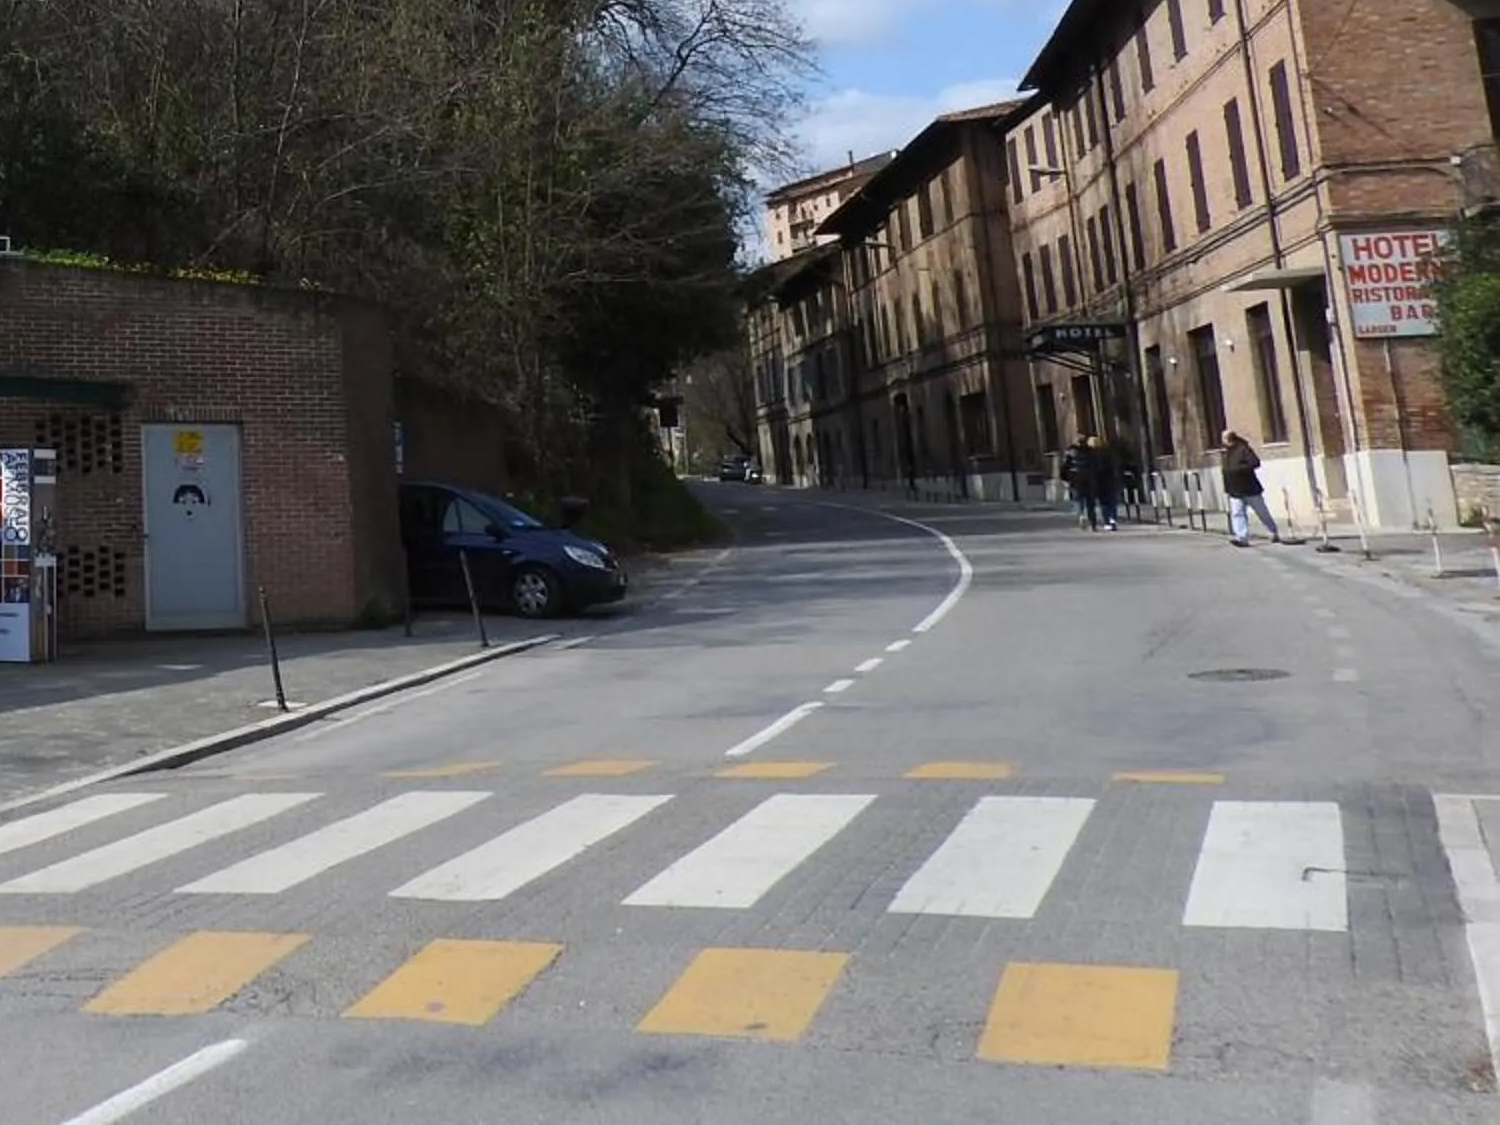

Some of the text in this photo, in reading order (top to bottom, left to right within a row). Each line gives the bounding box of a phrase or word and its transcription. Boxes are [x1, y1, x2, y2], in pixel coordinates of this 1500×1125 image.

[1352, 234, 1444, 261] HOTEL
[1347, 261, 1449, 285] MODERN
[1391, 304, 1434, 321] BAR
[1056, 327, 1114, 339] HOTEL
